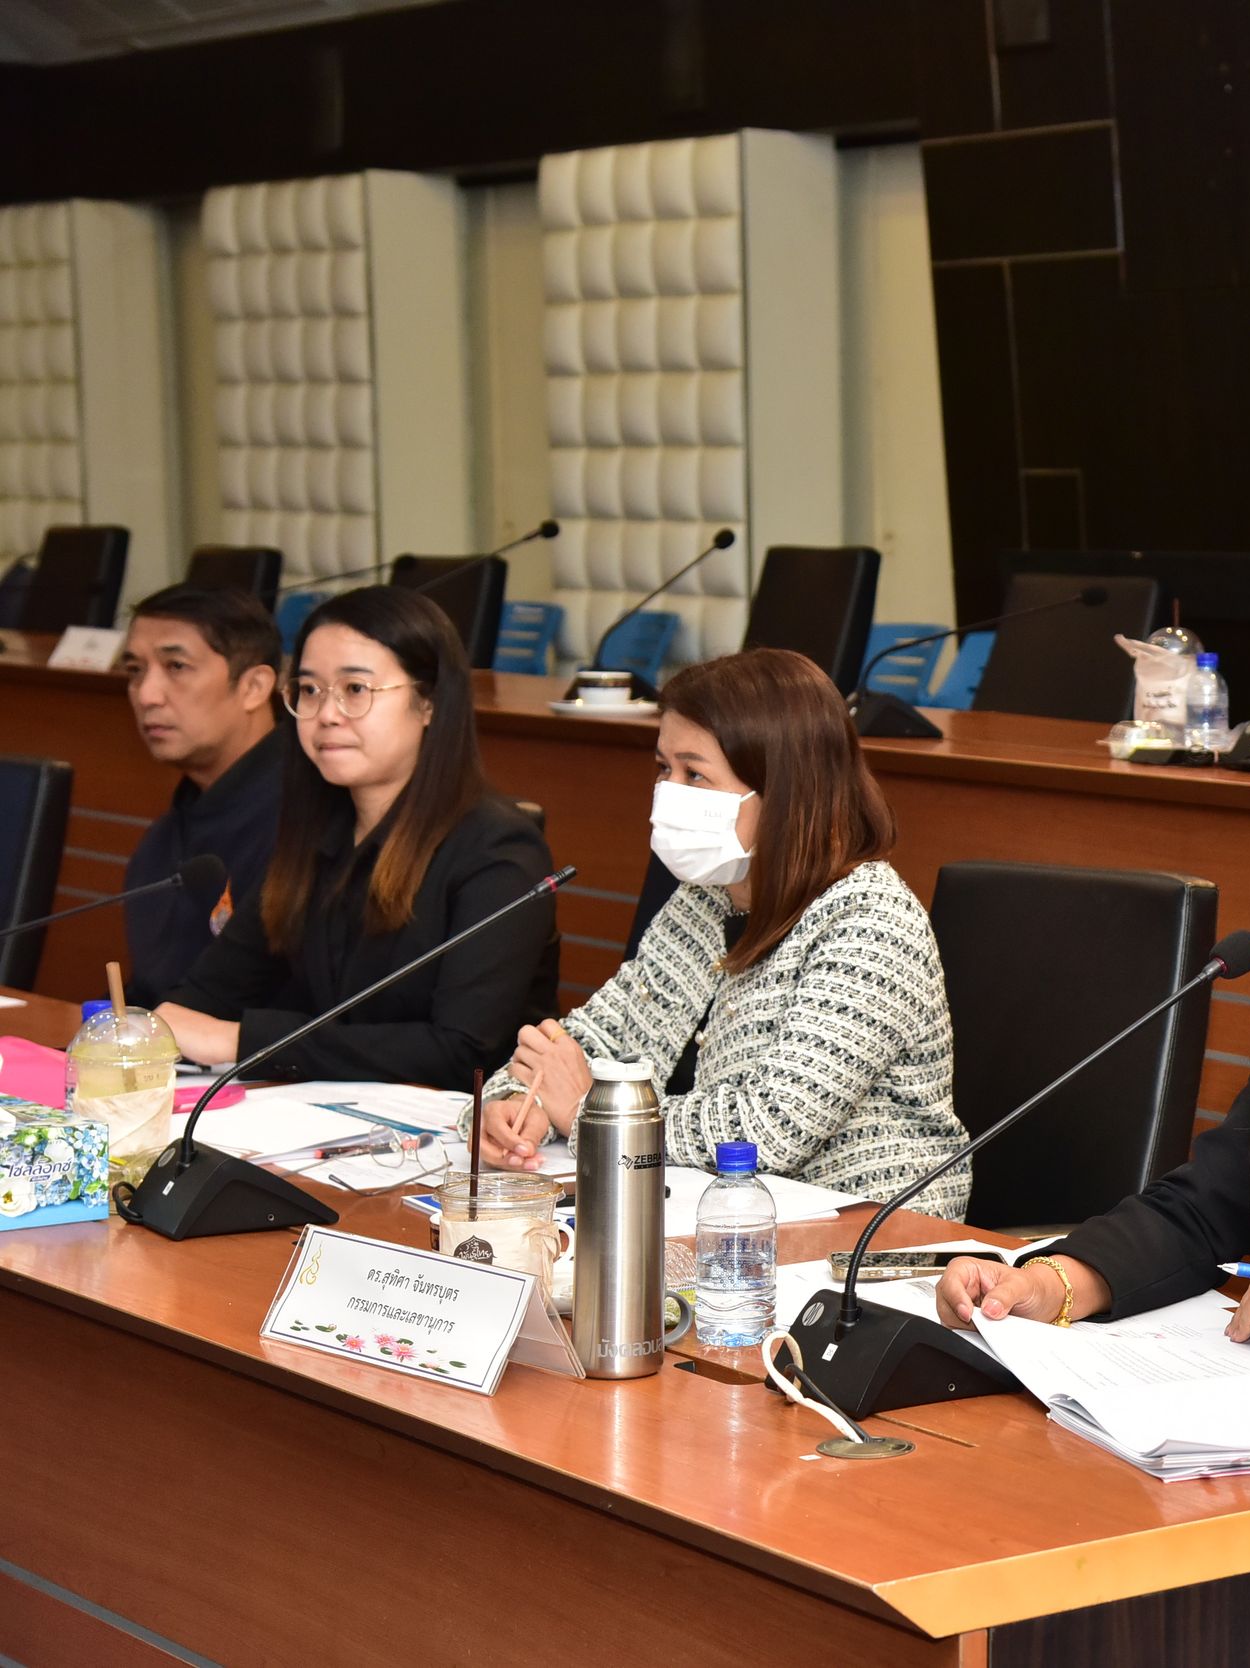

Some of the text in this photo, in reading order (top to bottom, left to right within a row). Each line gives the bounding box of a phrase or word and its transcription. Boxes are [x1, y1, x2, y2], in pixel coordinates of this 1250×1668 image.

[634, 1152, 662, 1164] ZEBRA
[366, 1268, 460, 1304] ดร.สุทิศา จันทรบุตร
[346, 1296, 456, 1335] กรรมการและเลขานุการ
